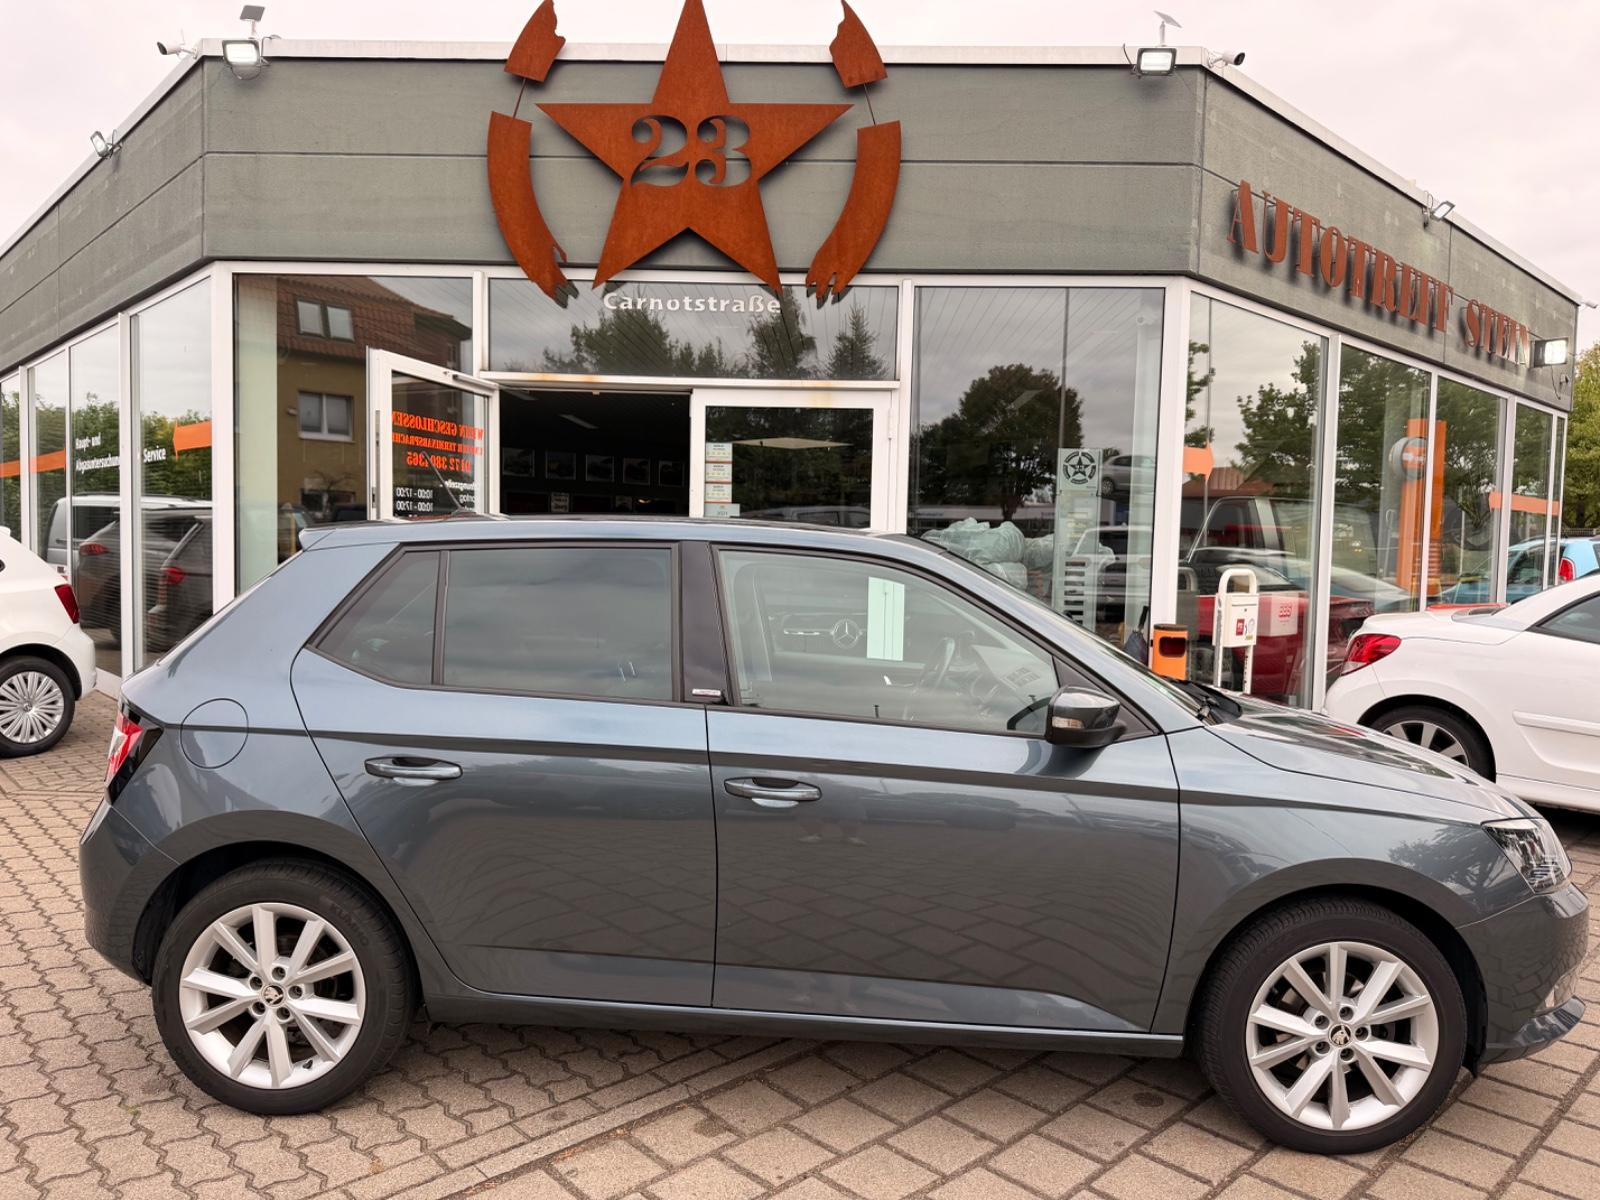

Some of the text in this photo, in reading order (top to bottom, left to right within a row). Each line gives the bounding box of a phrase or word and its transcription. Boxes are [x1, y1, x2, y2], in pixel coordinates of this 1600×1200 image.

[631, 115, 752, 188] 23
[603, 293, 781, 314] Carnotstraße
[143, 445, 166, 463] Service
